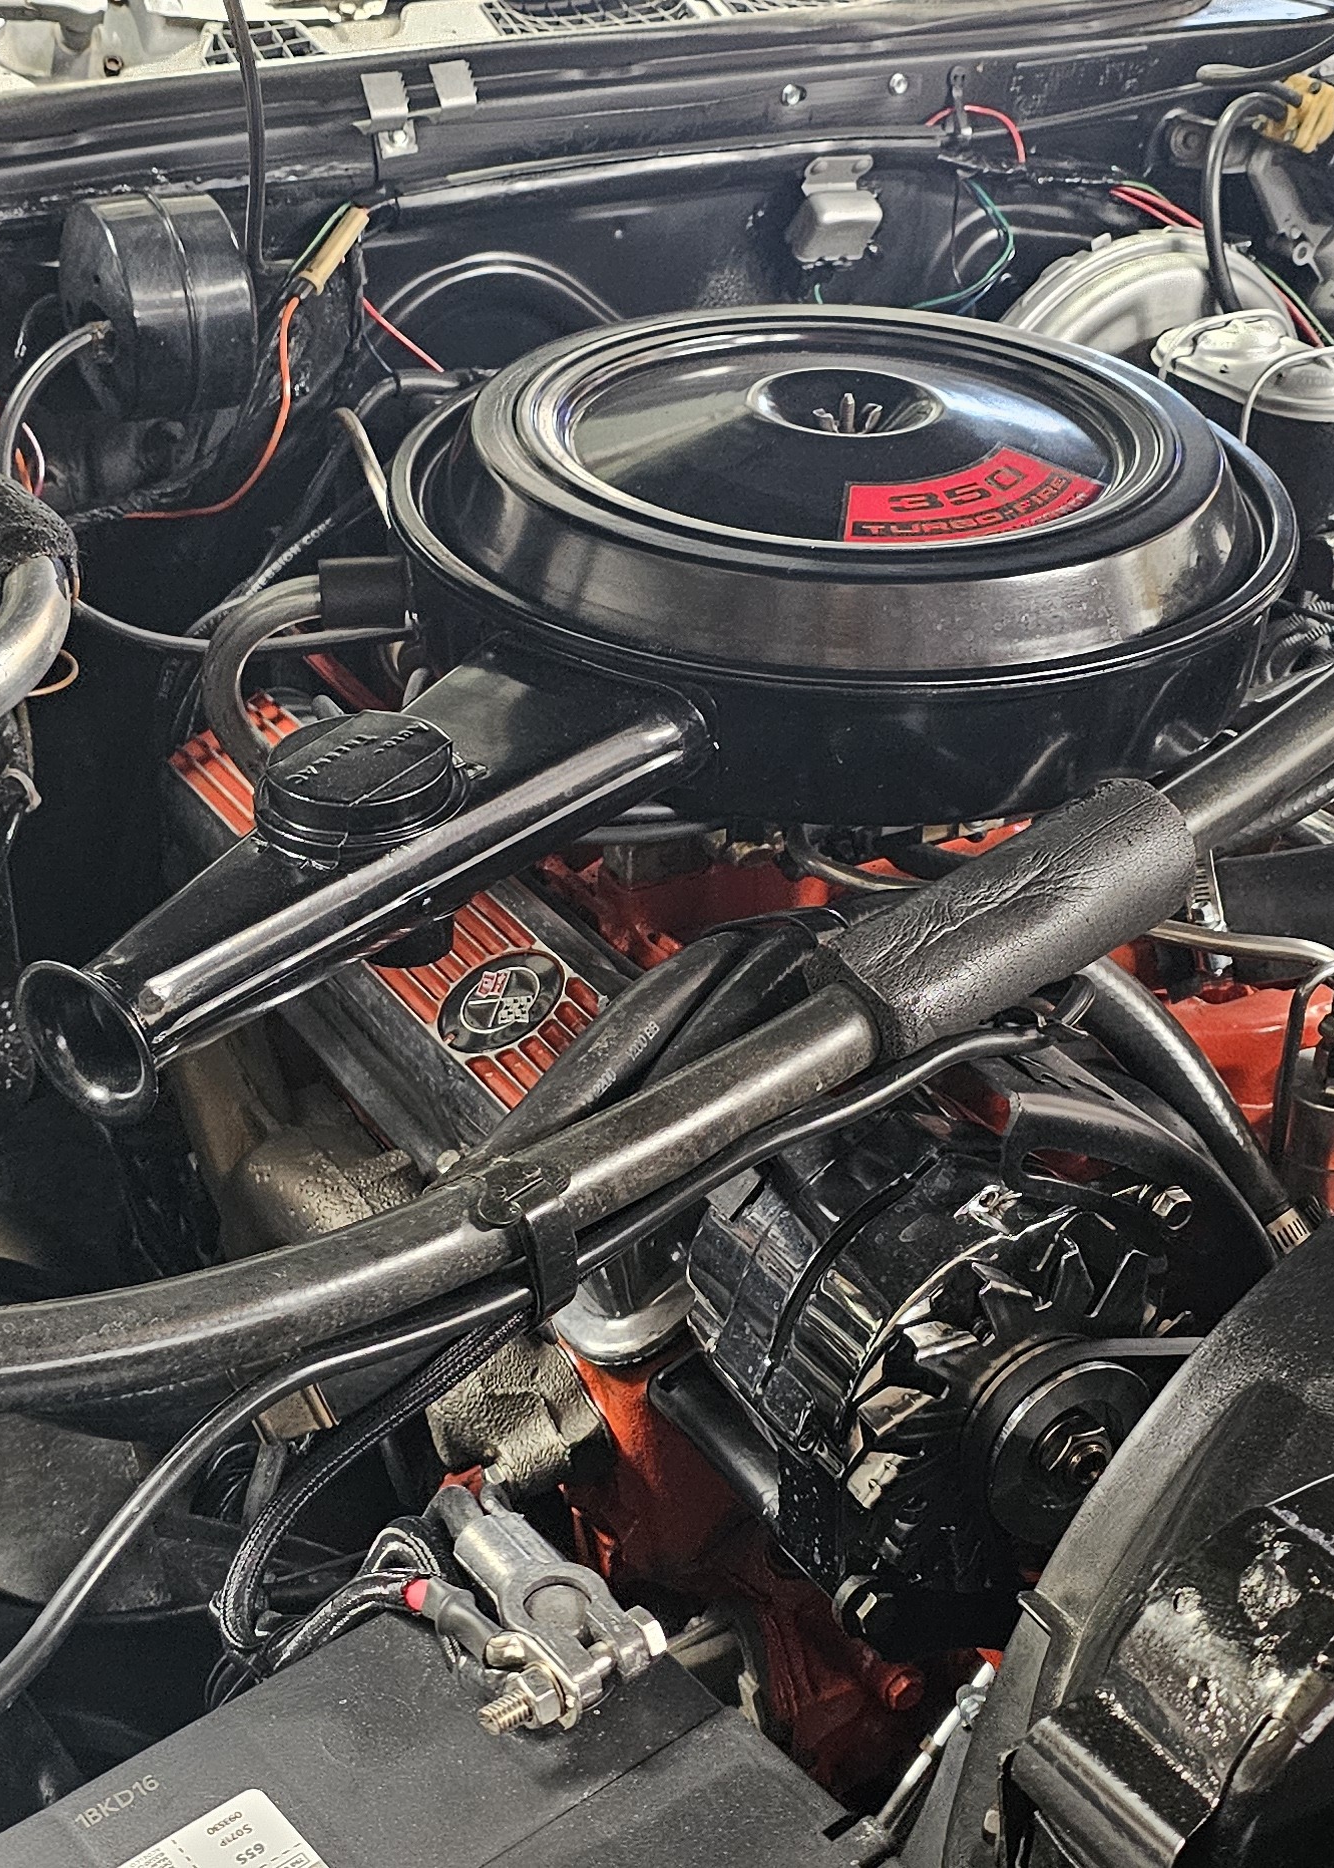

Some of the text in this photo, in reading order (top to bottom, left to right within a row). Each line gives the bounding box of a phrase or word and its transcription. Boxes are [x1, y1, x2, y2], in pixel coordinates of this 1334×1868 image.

[861, 472, 1072, 537] TURBO-FIRE
[888, 465, 1026, 512] 350
[75, 1774, 161, 1829] 1BKD16
[235, 1843, 266, 1865] 65S
